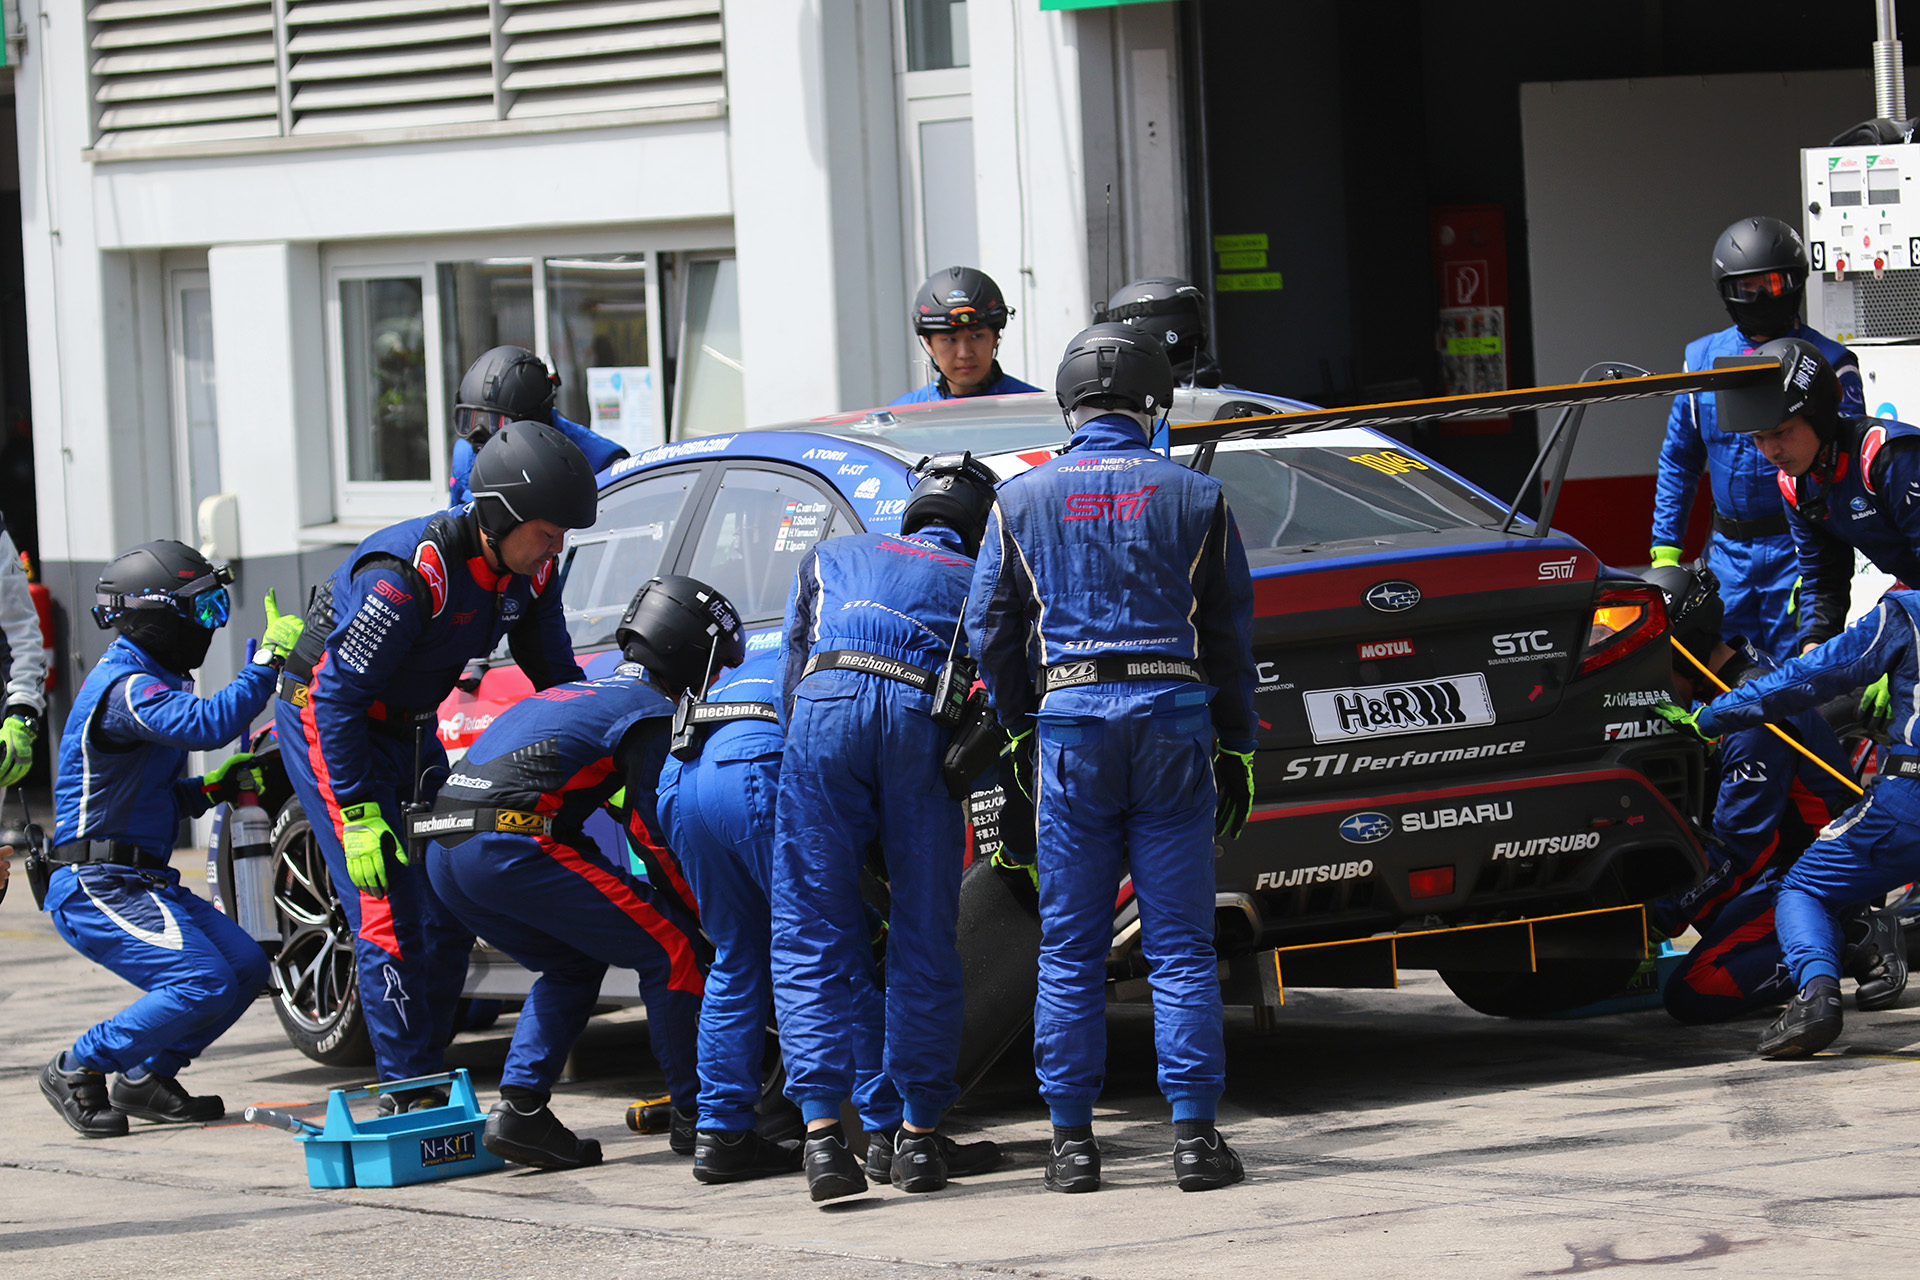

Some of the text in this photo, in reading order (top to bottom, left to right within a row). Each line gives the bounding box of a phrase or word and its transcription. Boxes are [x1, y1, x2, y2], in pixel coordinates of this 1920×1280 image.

[1812, 242, 1824, 269] 9
[1911, 238, 1920, 265] 8
[837, 463, 869, 476] N-KIT
[966, 464, 989, 481] ENTOS
[1057, 464, 1124, 473] CHALLENGE
[1077, 457, 1126, 466] STI NBR
[1062, 485, 1159, 521] STI
[1537, 556, 1578, 580] STI
[372, 579, 414, 606] STI
[840, 599, 871, 611] STI
[708, 599, 737, 632] 佐藤
[1062, 636, 1179, 650] STI Performance
[1361, 641, 1412, 659] MOTUL
[1492, 629, 1553, 656] STC
[837, 653, 926, 685] mechanix.com
[1334, 690, 1420, 732] H&R
[1604, 718, 1678, 742] FALKE
[1282, 740, 1526, 781] STI Performance
[413, 814, 474, 834] mechanix.com
[972, 811, 1000, 827] 富士スバ
[1401, 801, 1513, 832] SUBARU
[1492, 832, 1600, 860] FUJITSUBO
[1255, 859, 1374, 890] FUJITSUBO
